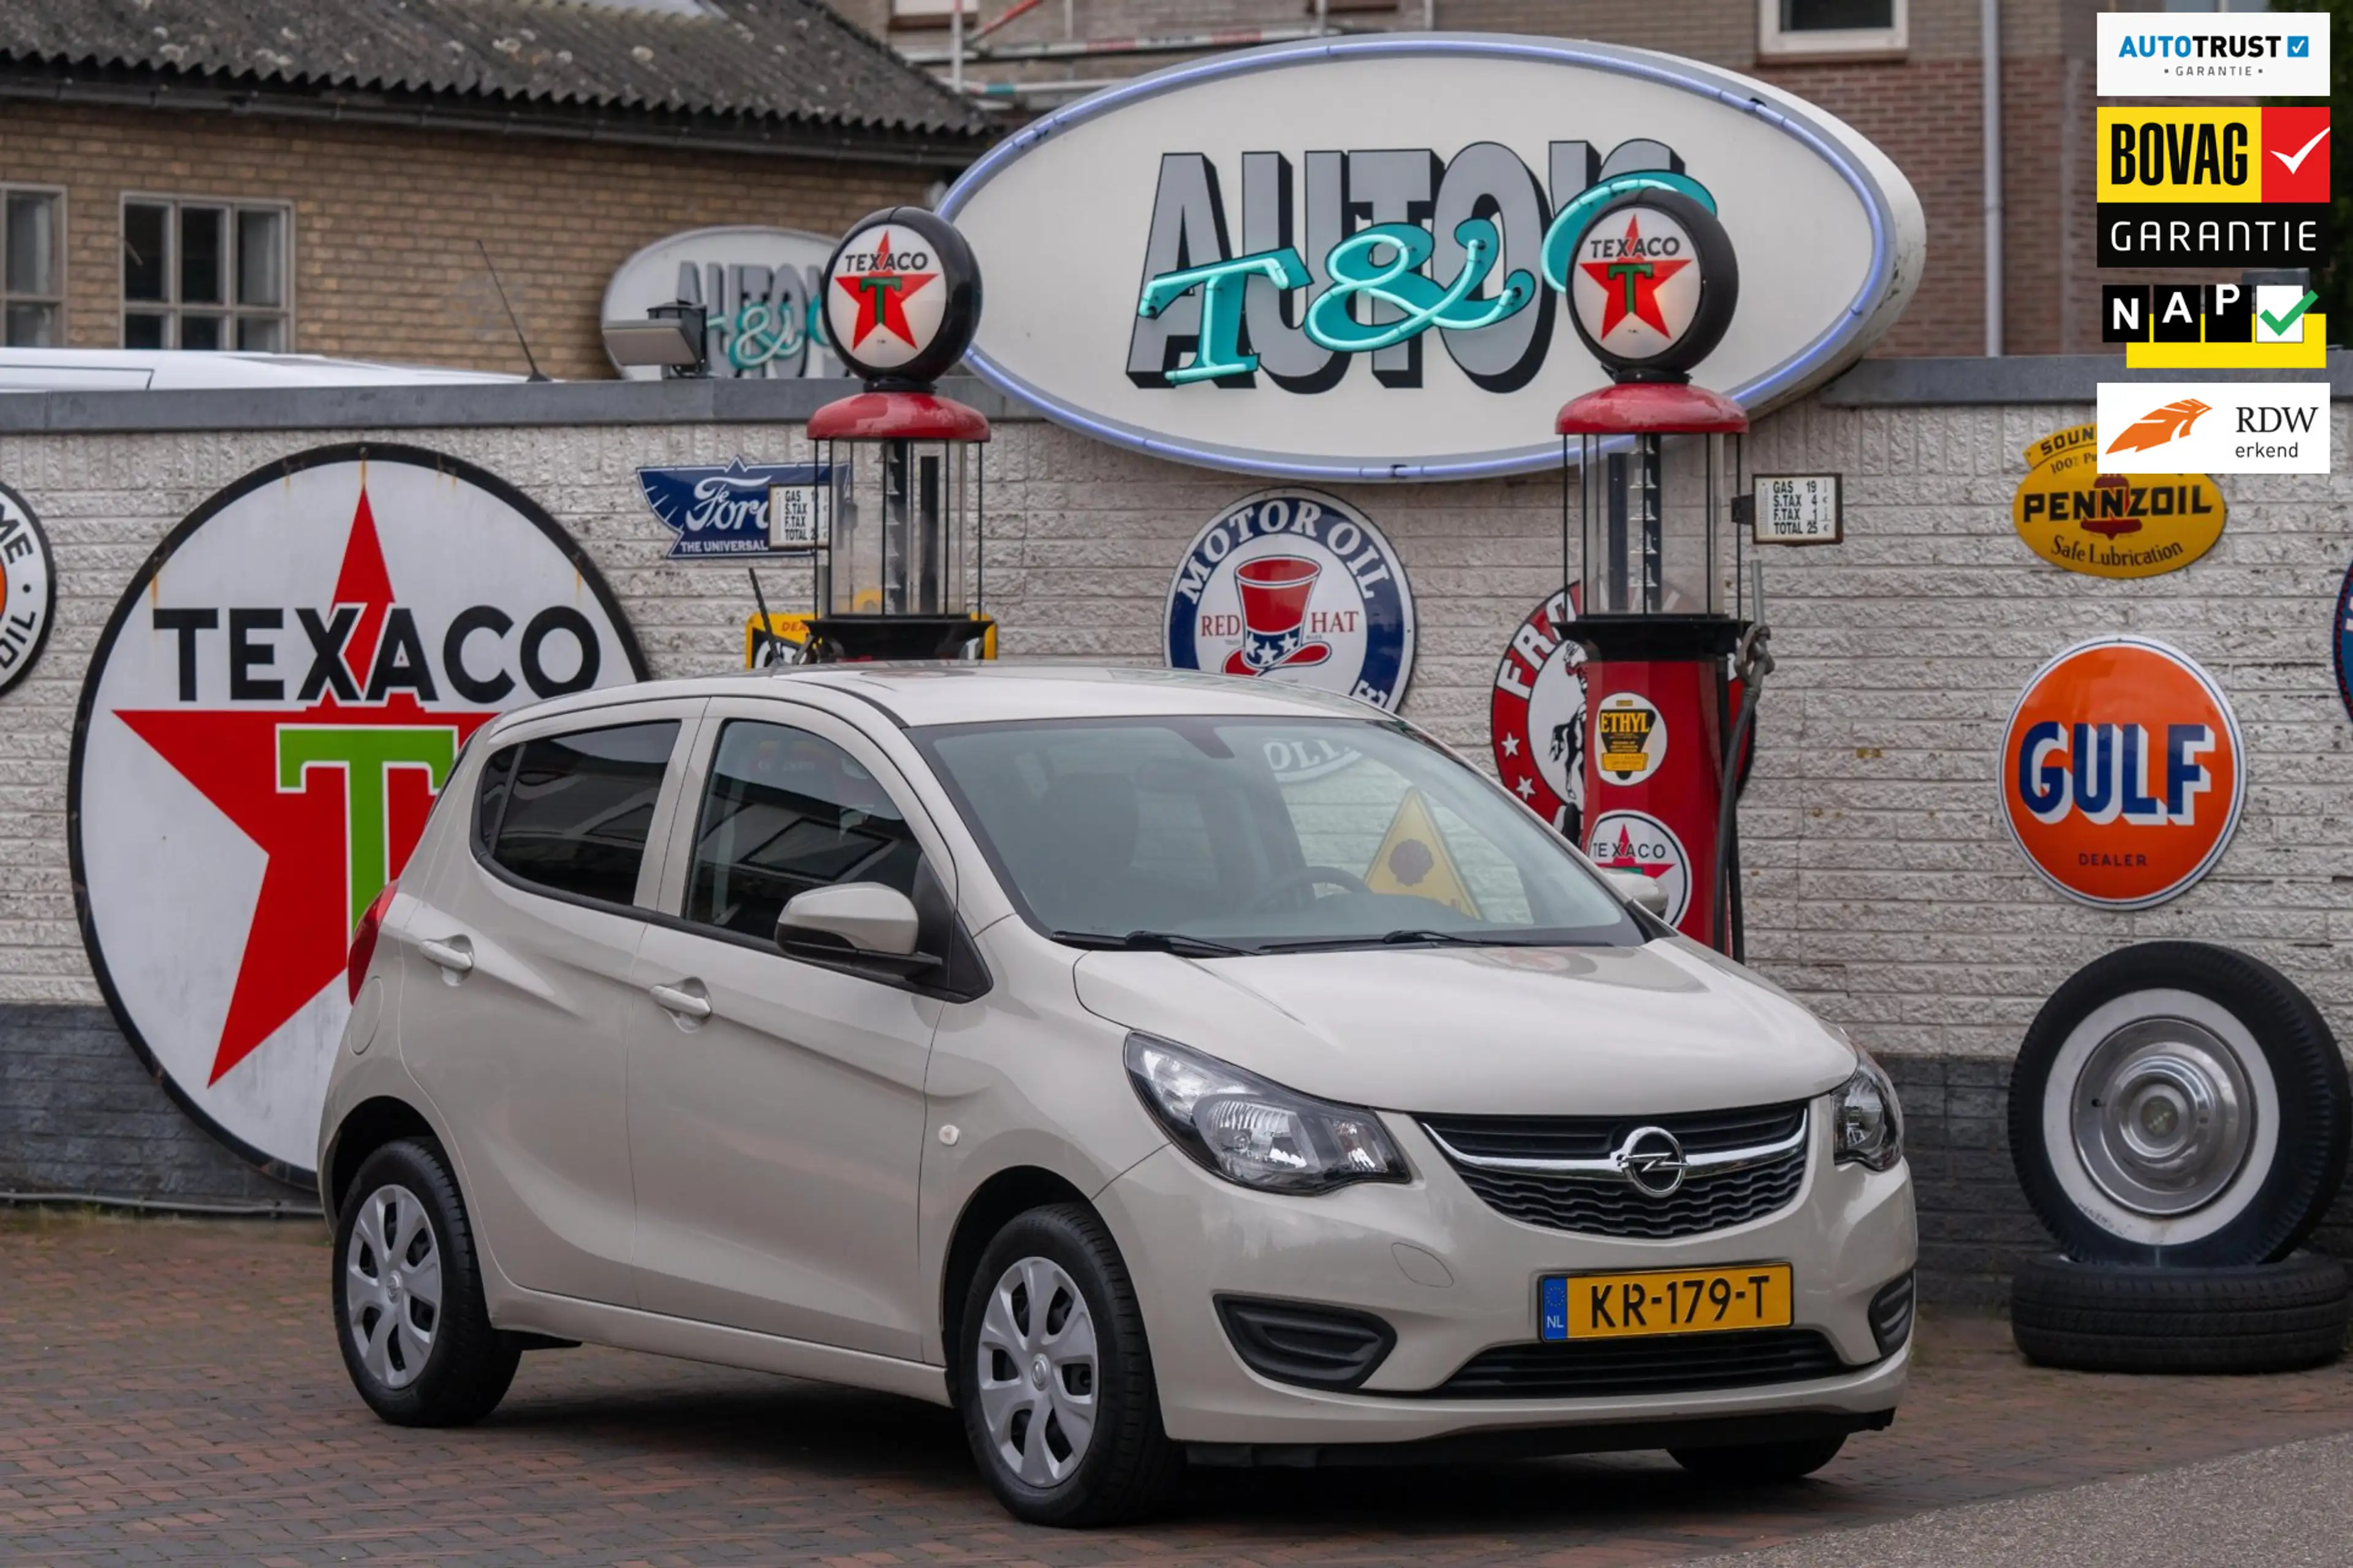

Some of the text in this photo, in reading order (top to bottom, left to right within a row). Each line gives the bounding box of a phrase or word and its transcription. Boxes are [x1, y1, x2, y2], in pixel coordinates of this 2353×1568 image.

[1591, 237, 1681, 259] TEXACO
[845, 252, 928, 272] TEXACO
[2040, 426, 2097, 456] SOUN
[785, 490, 801, 502] GAS
[1773, 480, 1817, 493] GAS 19
[2023, 485, 2215, 523] PENNZOIL
[785, 528, 809, 540] TOTAL
[1774, 522, 1803, 535] TOTAL
[680, 539, 769, 553] THE UNIVERSAL
[1177, 499, 1390, 605] MOTOR OIL
[2051, 534, 2184, 566] Safe Lubrication
[1200, 610, 1359, 637] RED HAT
[154, 605, 601, 704] TEXACO
[1600, 711, 1651, 733] ETHYL
[2018, 721, 2215, 825] GULF
[1593, 842, 1666, 859] TEXACO
[2079, 852, 2148, 867] DEALER
[1546, 1274, 1770, 1330] NL KR-179-T
